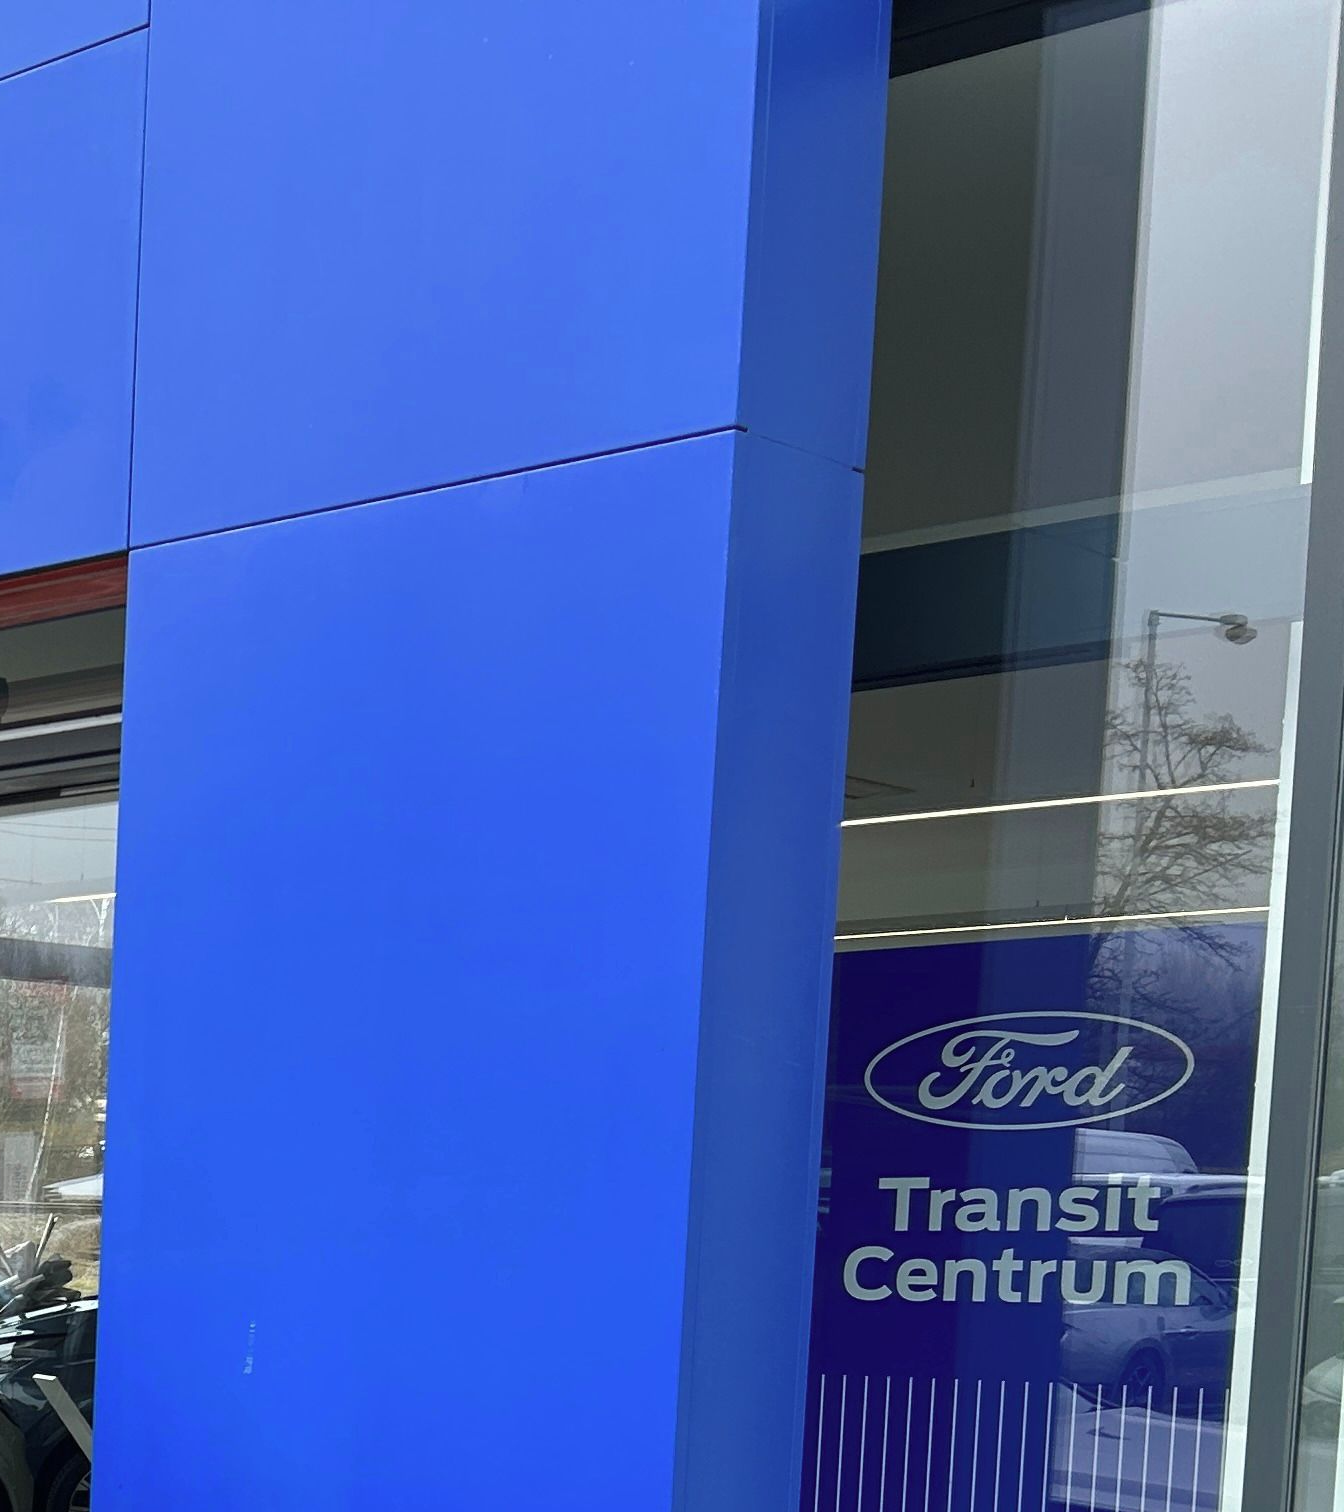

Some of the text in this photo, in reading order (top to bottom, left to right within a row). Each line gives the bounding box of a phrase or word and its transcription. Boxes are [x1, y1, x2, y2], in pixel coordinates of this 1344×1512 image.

[918, 1029, 1134, 1110] Ford
[878, 1175, 1161, 1233] Transit
[843, 1245, 1192, 1306] Centrum
